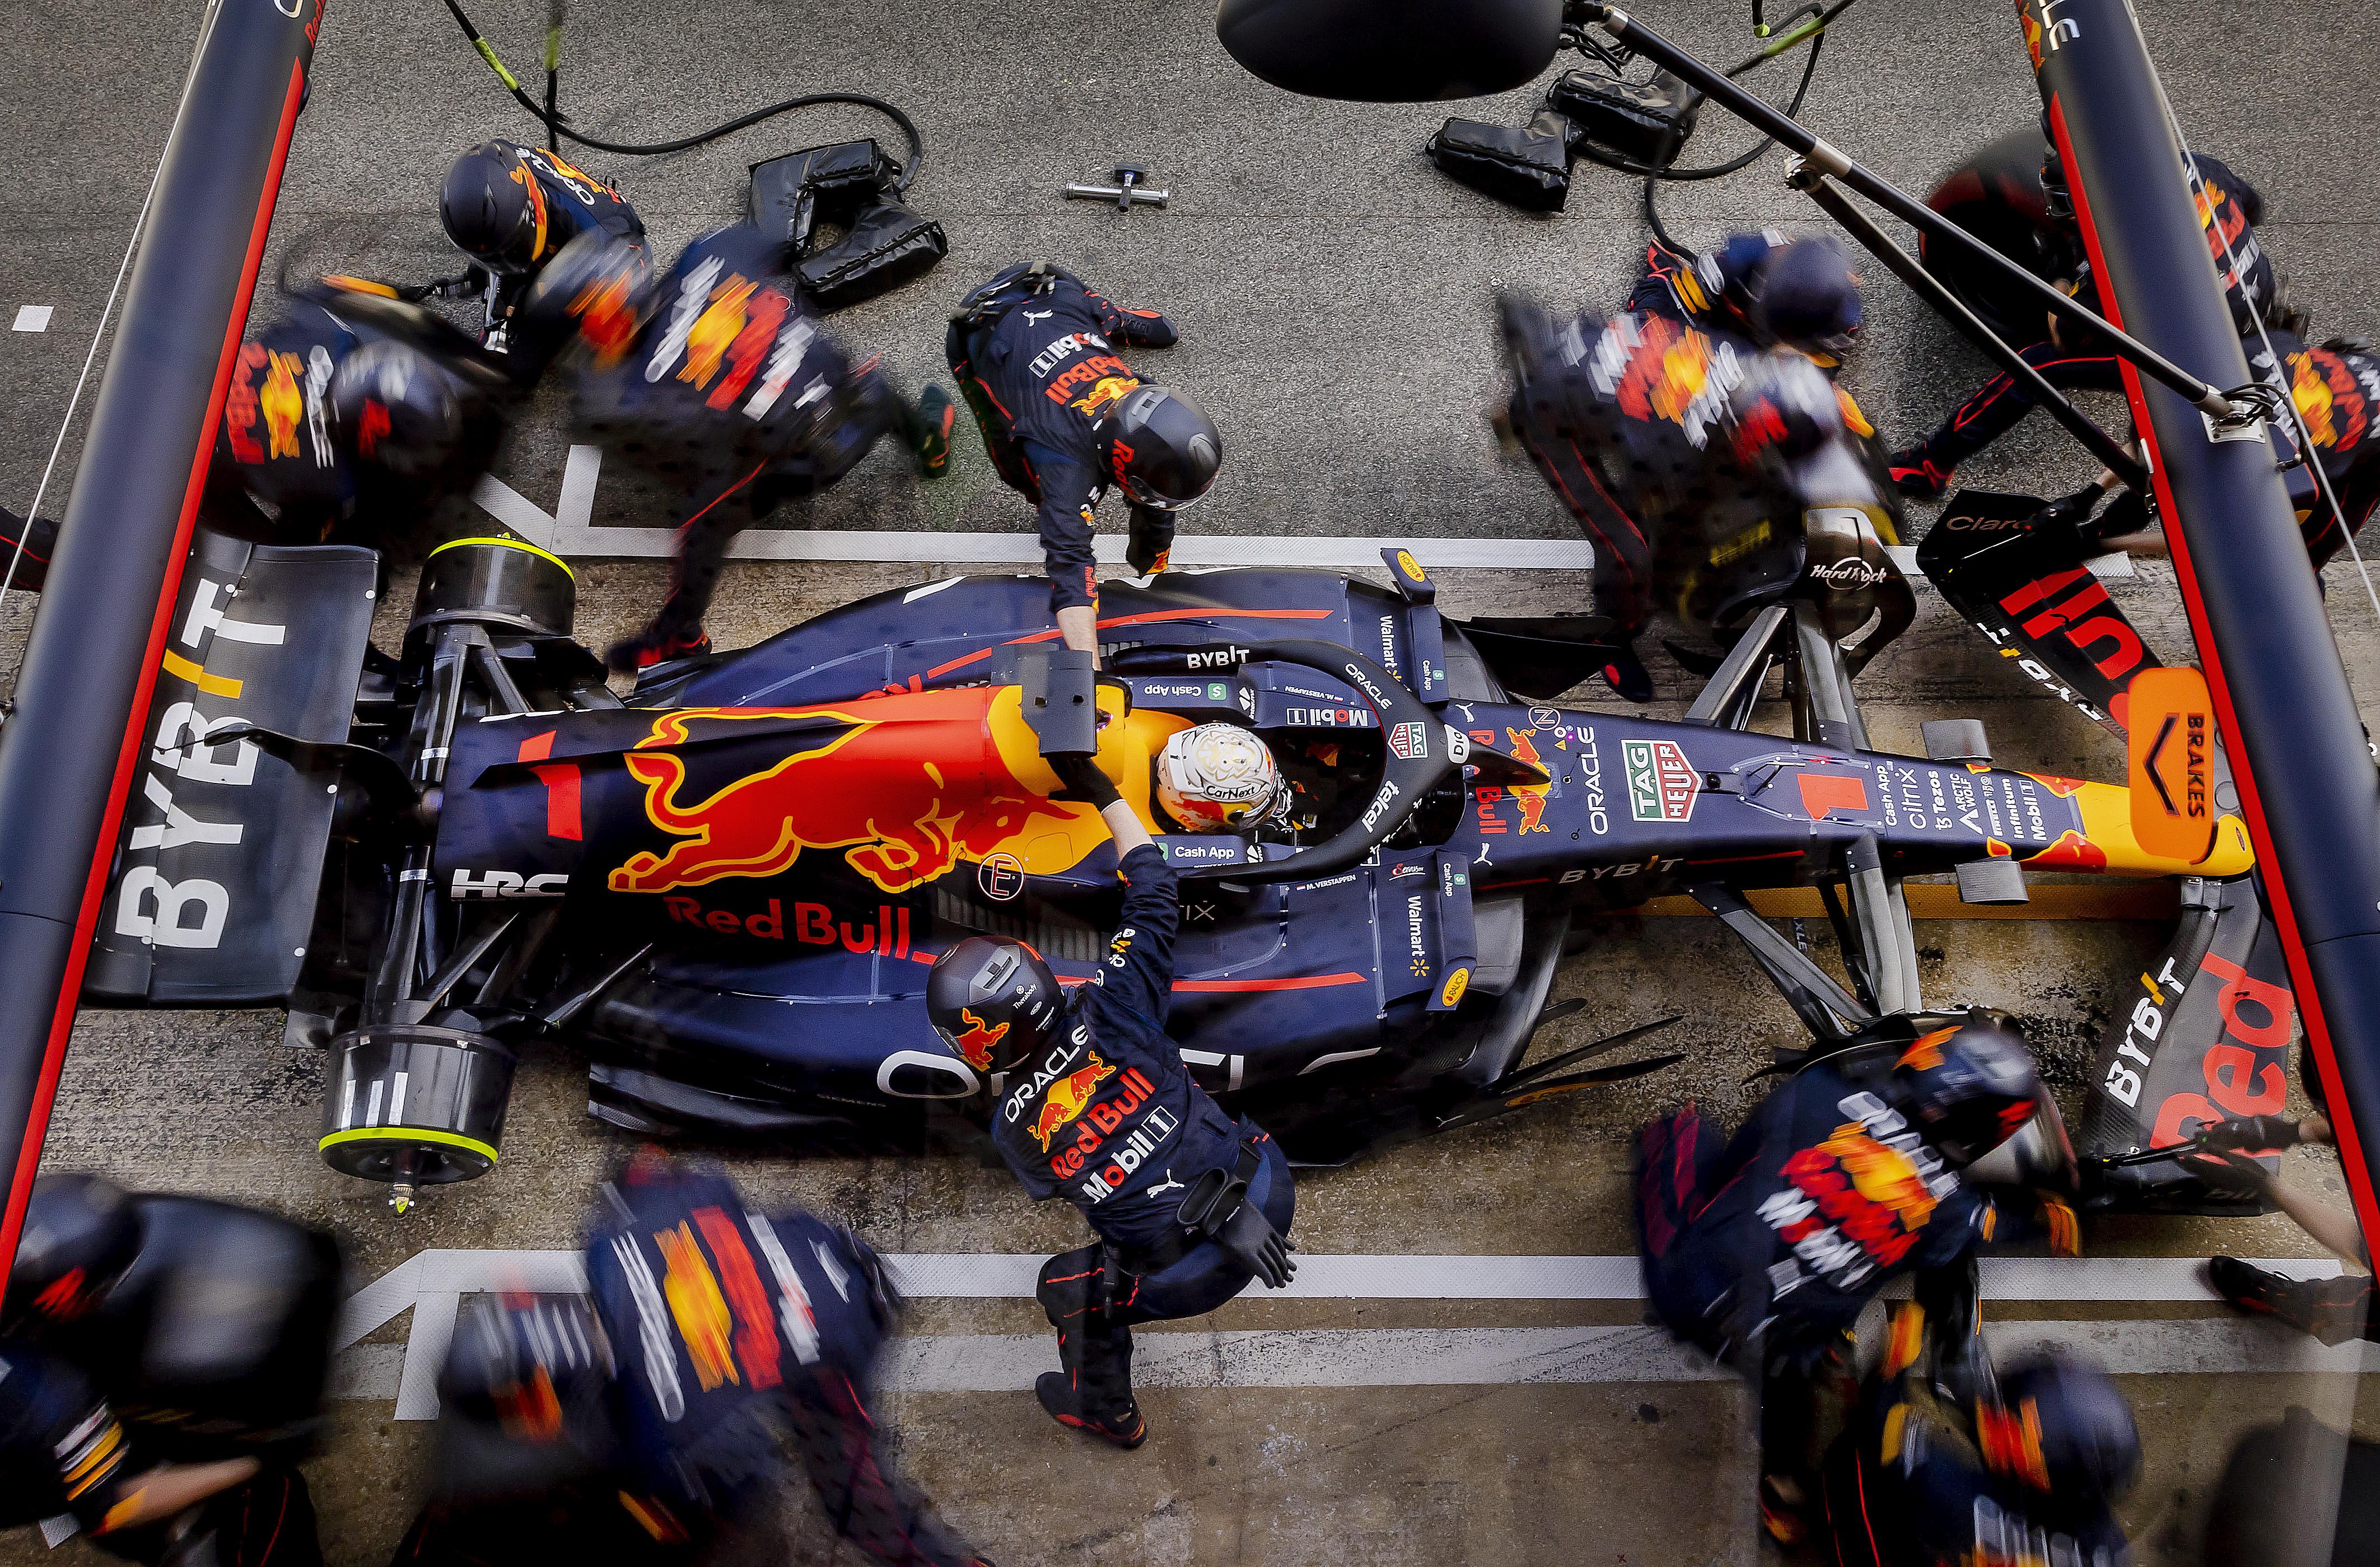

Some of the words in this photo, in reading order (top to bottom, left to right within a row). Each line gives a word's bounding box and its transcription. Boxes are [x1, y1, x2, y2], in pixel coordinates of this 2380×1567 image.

[1045, 361, 1100, 405] Bull
[1401, 554, 1418, 575] RAUCH
[1810, 565, 1854, 580] Hard
[1187, 645, 1250, 669] BYBIT
[1380, 615, 1398, 668] Walmart
[1999, 563, 2143, 731] ull
[1345, 663, 1393, 710] ORACLE
[1422, 660, 1431, 677] Cash
[1144, 684, 1170, 696] App
[1171, 685, 1202, 697] Cash
[1309, 708, 1368, 726] Mobil
[1393, 725, 1409, 756] HEUER
[1411, 725, 1424, 755] TAG
[115, 578, 286, 949] BYBIT
[1576, 725, 1609, 835] ORACLE
[1632, 747, 1656, 814] TAG
[1659, 745, 1693, 817] HEUER
[1877, 765, 1891, 792] App
[2187, 713, 2205, 818] BRAKES
[1206, 785, 1256, 800] CarNext
[1361, 780, 1400, 833] telcel
[1475, 786, 1507, 834] Bull
[1882, 794, 1898, 827] Cash
[1928, 770, 1947, 814] Tezos
[1949, 773, 1968, 812] ARCTIC
[1960, 777, 1976, 808] WOLF
[2001, 778, 2024, 839] Infinitum
[2023, 796, 2047, 841] Mobil
[1175, 846, 1206, 858] Cash
[1208, 846, 1235, 859] App
[1443, 863, 1452, 880] Cash
[1558, 855, 1683, 884] BYBIT
[451, 869, 569, 898] HRC
[1445, 881, 1453, 897] App
[662, 896, 783, 939] Red
[795, 902, 911, 959] Bull
[1408, 895, 1425, 957] Walmart
[1012, 983, 1038, 1010] Therabody
[1448, 972, 1466, 996] RAUCH
[2104, 957, 2185, 1108] BYBIT
[1004, 1024, 1089, 1124] ORACLE
[1050, 1127, 1102, 1179] Red
[1087, 1066, 1155, 1135] Bull
[1081, 1128, 1155, 1204] Mobil
